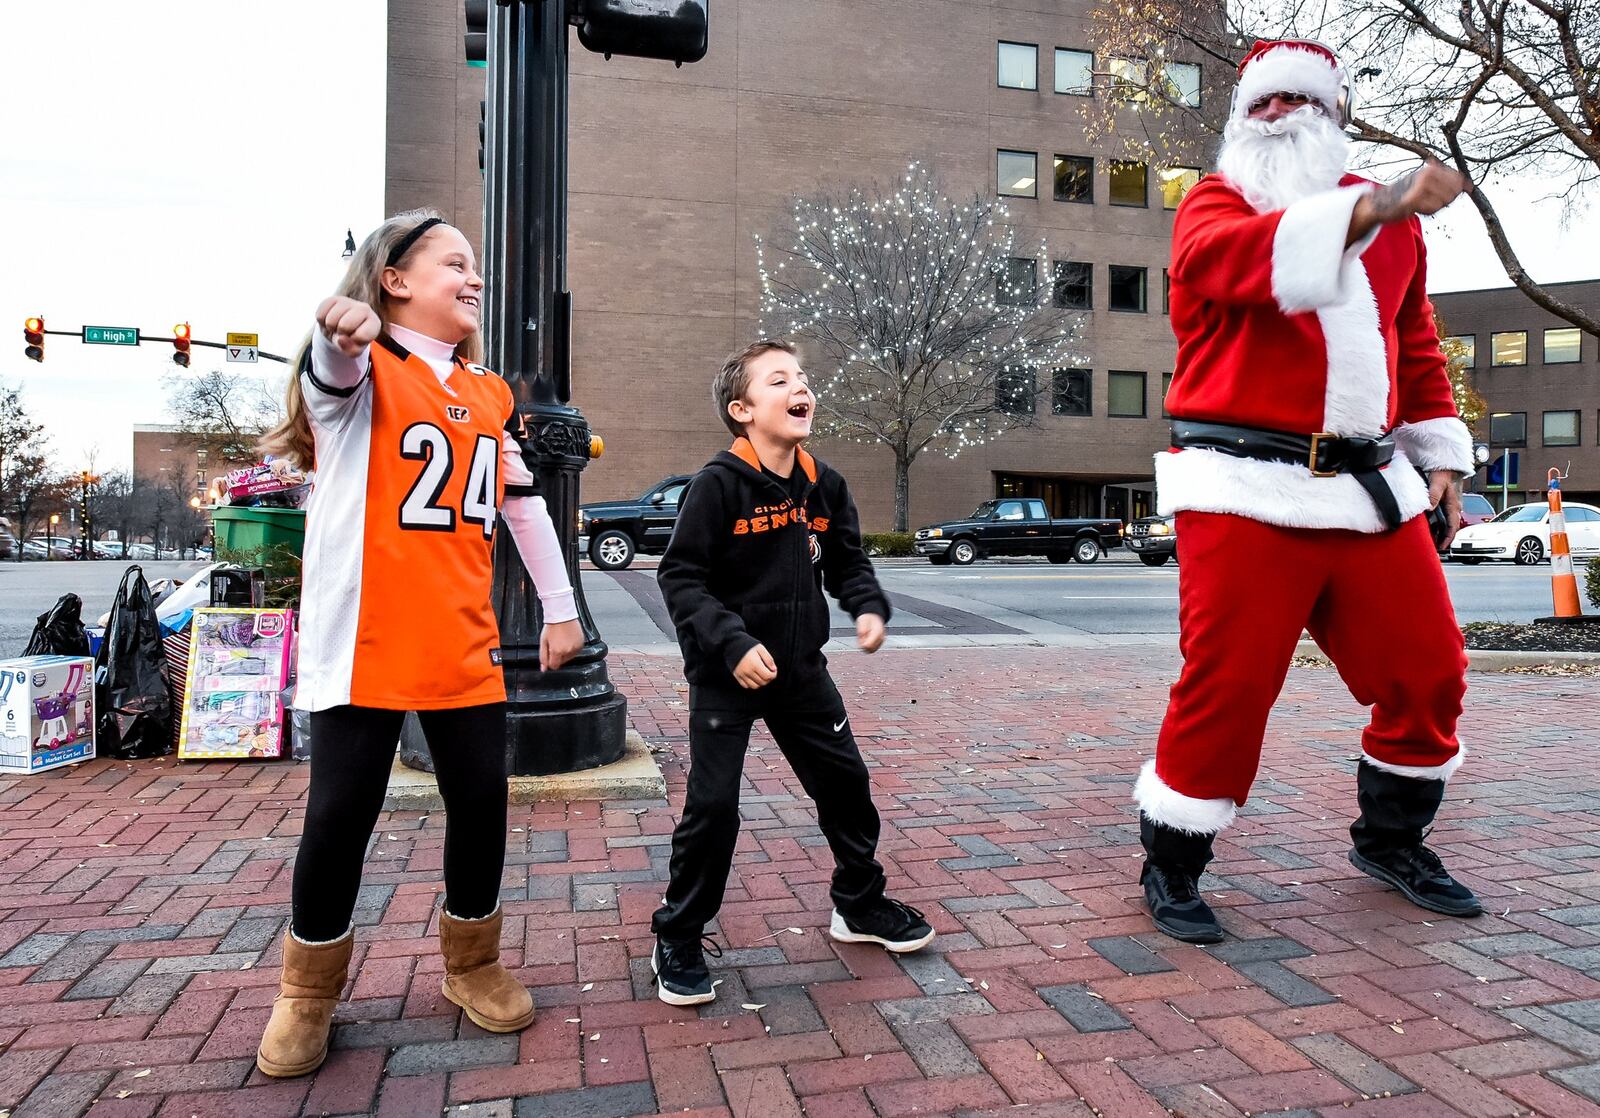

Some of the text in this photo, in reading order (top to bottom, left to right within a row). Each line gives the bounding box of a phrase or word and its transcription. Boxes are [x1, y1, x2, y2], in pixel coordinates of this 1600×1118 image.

[103, 330, 125, 343] High
[398, 421, 499, 542] 24
[733, 506, 830, 535] BENGS
[7, 710, 14, 721] 6
[45, 755, 62, 764] Market
